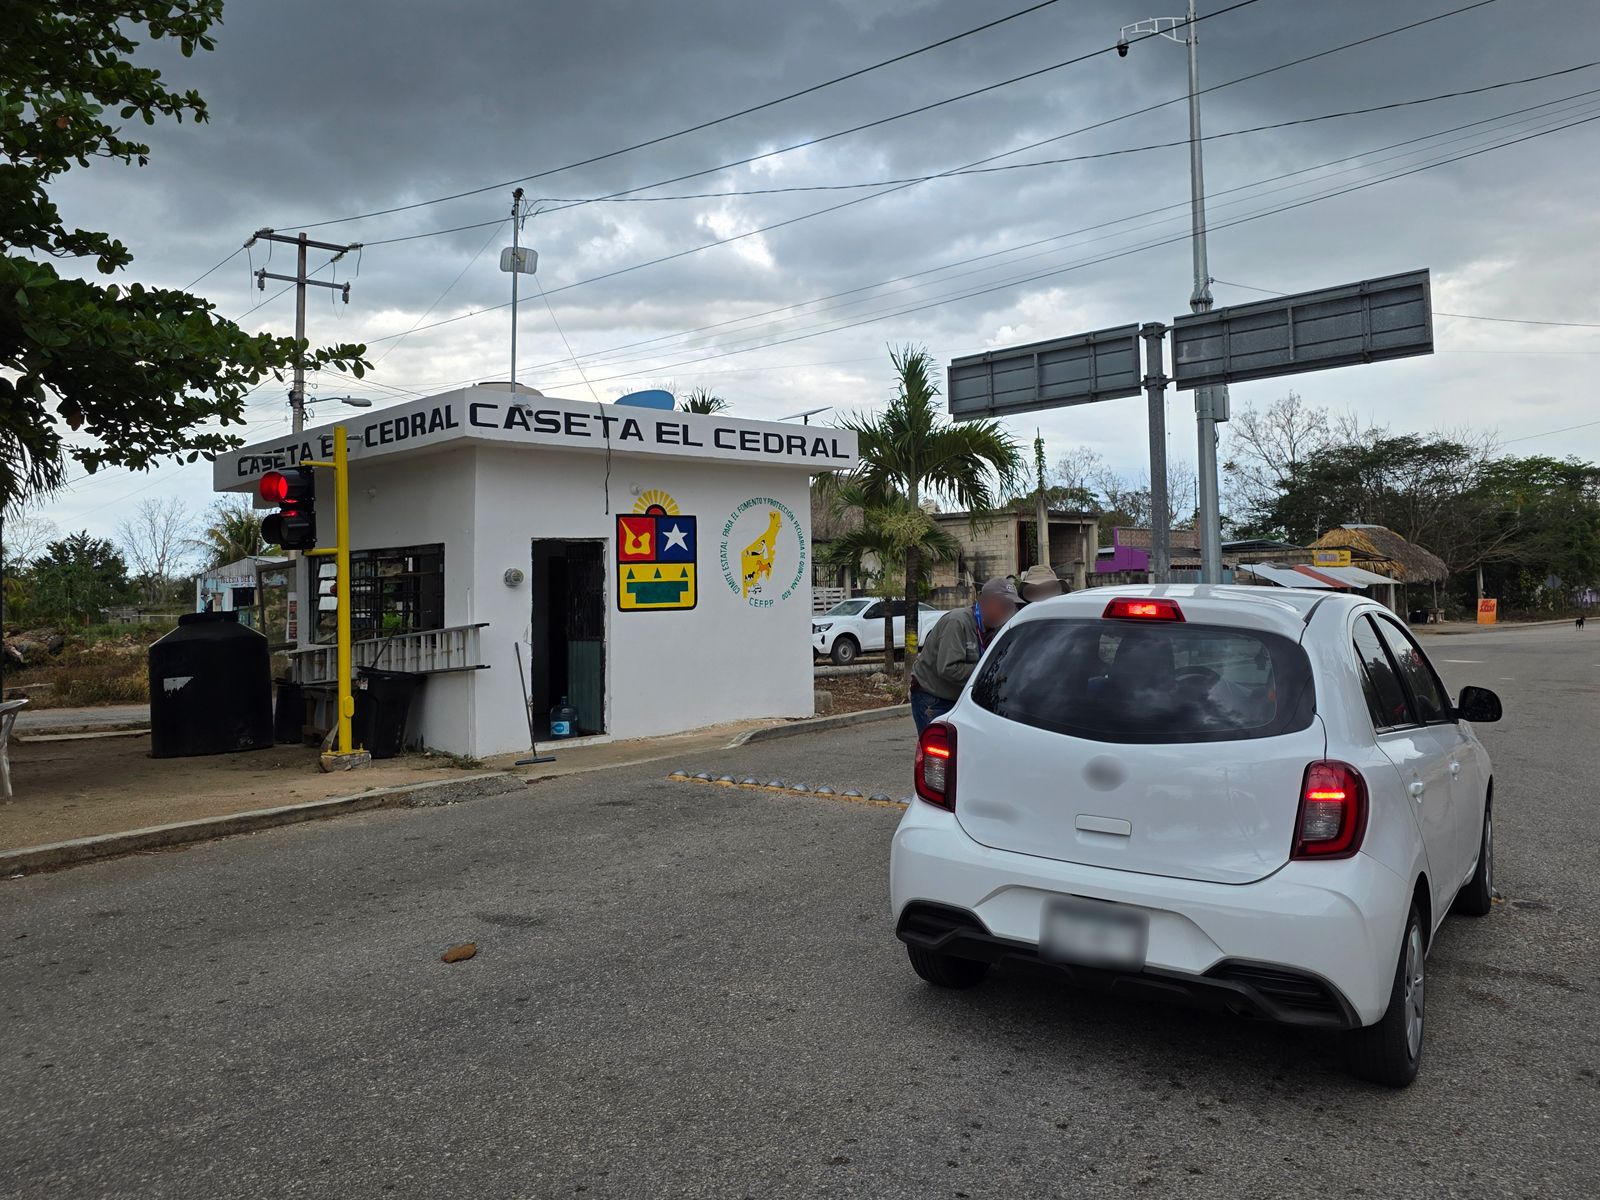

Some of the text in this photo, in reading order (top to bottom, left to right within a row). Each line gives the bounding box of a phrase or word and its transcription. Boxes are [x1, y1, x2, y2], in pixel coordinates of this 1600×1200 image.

[237, 404, 459, 477] CASETA E CEDRAL
[469, 402, 850, 460] CASETA EL CEDRAL
[731, 511, 739, 521] EL
[737, 497, 763, 513] FOMENTO
[722, 519, 734, 537] PARA
[793, 520, 806, 551] PECUARIA
[719, 541, 730, 571] ESTATAL
[799, 552, 806, 560] DE
[790, 560, 805, 590] QUINTANA
